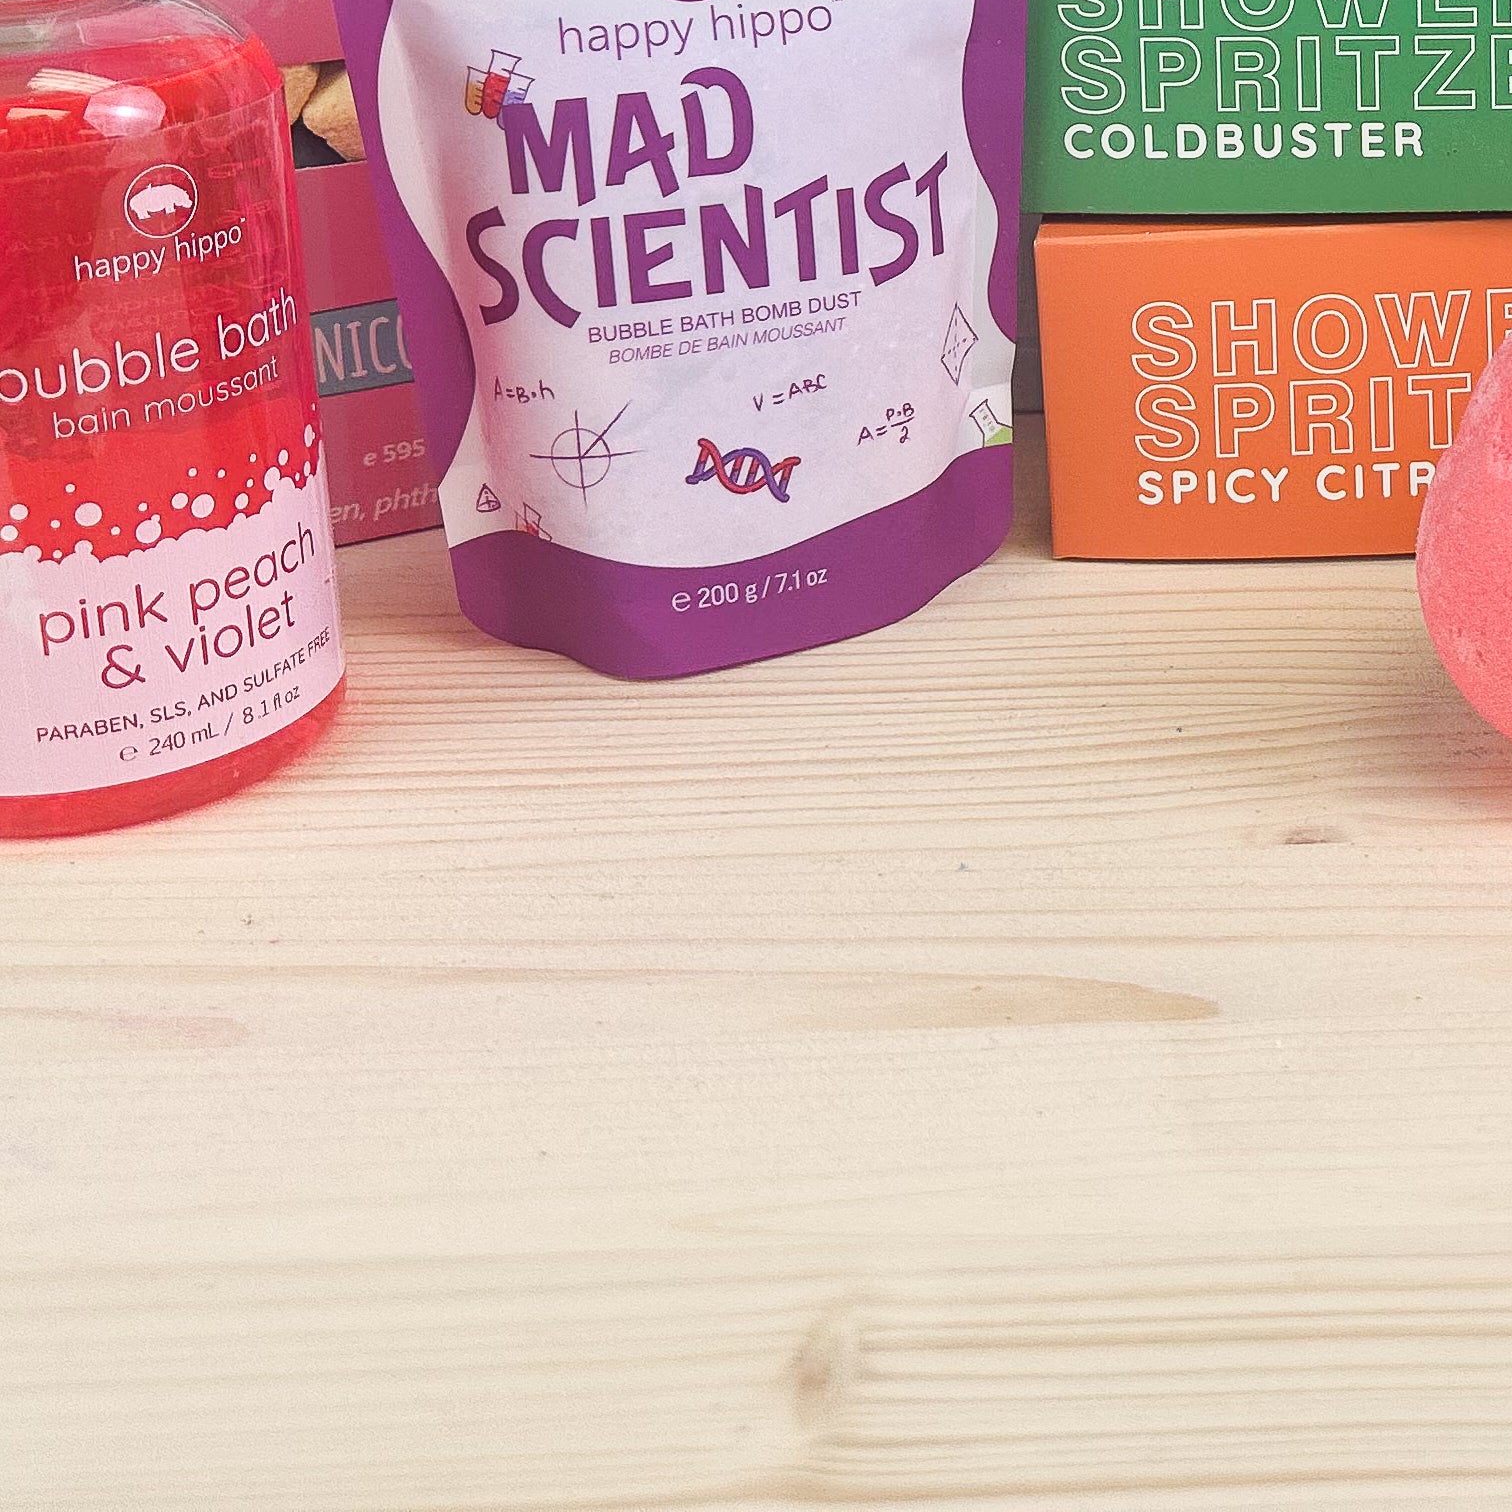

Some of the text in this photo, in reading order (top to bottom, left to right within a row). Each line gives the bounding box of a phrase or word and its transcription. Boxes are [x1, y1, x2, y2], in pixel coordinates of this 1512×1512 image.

[558, 3, 833, 61] happy hippo
[503, 65, 756, 207] MAD
[1062, 121, 1425, 161] COLDBUSTER
[74, 224, 243, 282] happy hippo
[465, 150, 948, 329] SCIENTIST
[216, 286, 298, 361] bath
[314, 314, 413, 383] NIC
[588, 290, 863, 344] BUBBLE BATH BOMB DUST
[608, 317, 848, 364] BOMBE DE BAIN MOUSSANT
[52, 355, 280, 439] bain moussant
[1134, 372, 1473, 463] SPRIT
[382, 438, 427, 463] 595
[1138, 461, 1437, 506] SPICY CITR
[329, 482, 438, 524] en, phth
[38, 520, 315, 657] pink peach
[696, 582, 740, 609] 200
[743, 585, 759, 606] g
[774, 571, 802, 595] 7.1
[805, 567, 829, 586] oz
[100, 590, 296, 690] & violet
[36, 625, 331, 743] PARABEN, SLS, AND SULFATE FREE
[148, 730, 186, 757] 240
[191, 721, 221, 746] mL
[222, 711, 235, 737] /
[242, 699, 270, 725] 8.1
[272, 691, 283, 712] fl
[284, 685, 302, 705] oz
